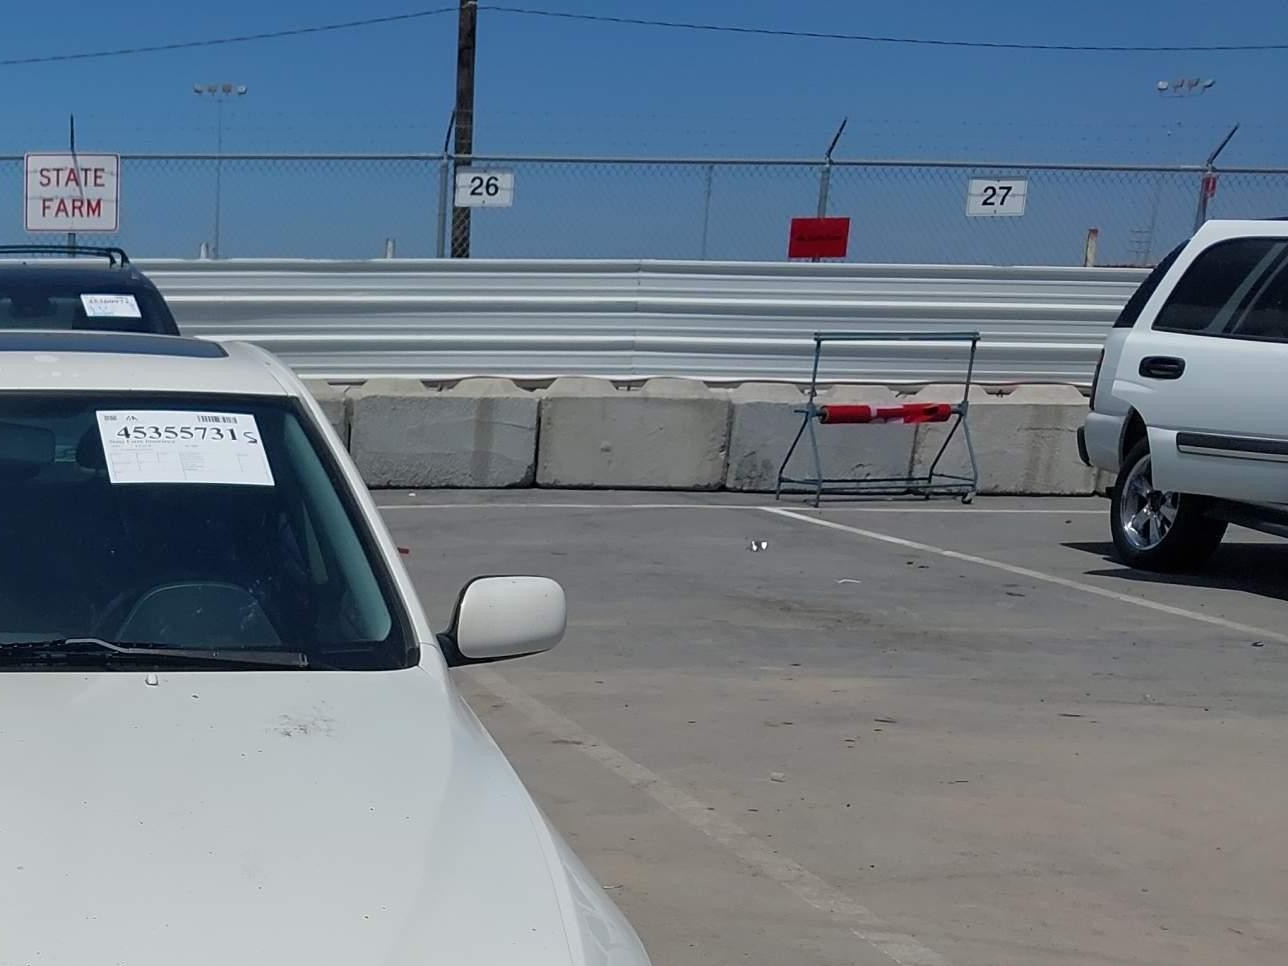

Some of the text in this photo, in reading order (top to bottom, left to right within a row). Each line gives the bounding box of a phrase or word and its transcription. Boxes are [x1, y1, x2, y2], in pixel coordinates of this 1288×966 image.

[39, 167, 105, 187] STATE
[469, 176, 499, 197] 26
[981, 185, 1013, 206] 27
[41, 198, 102, 218] FARM
[116, 425, 238, 441] 45355731
